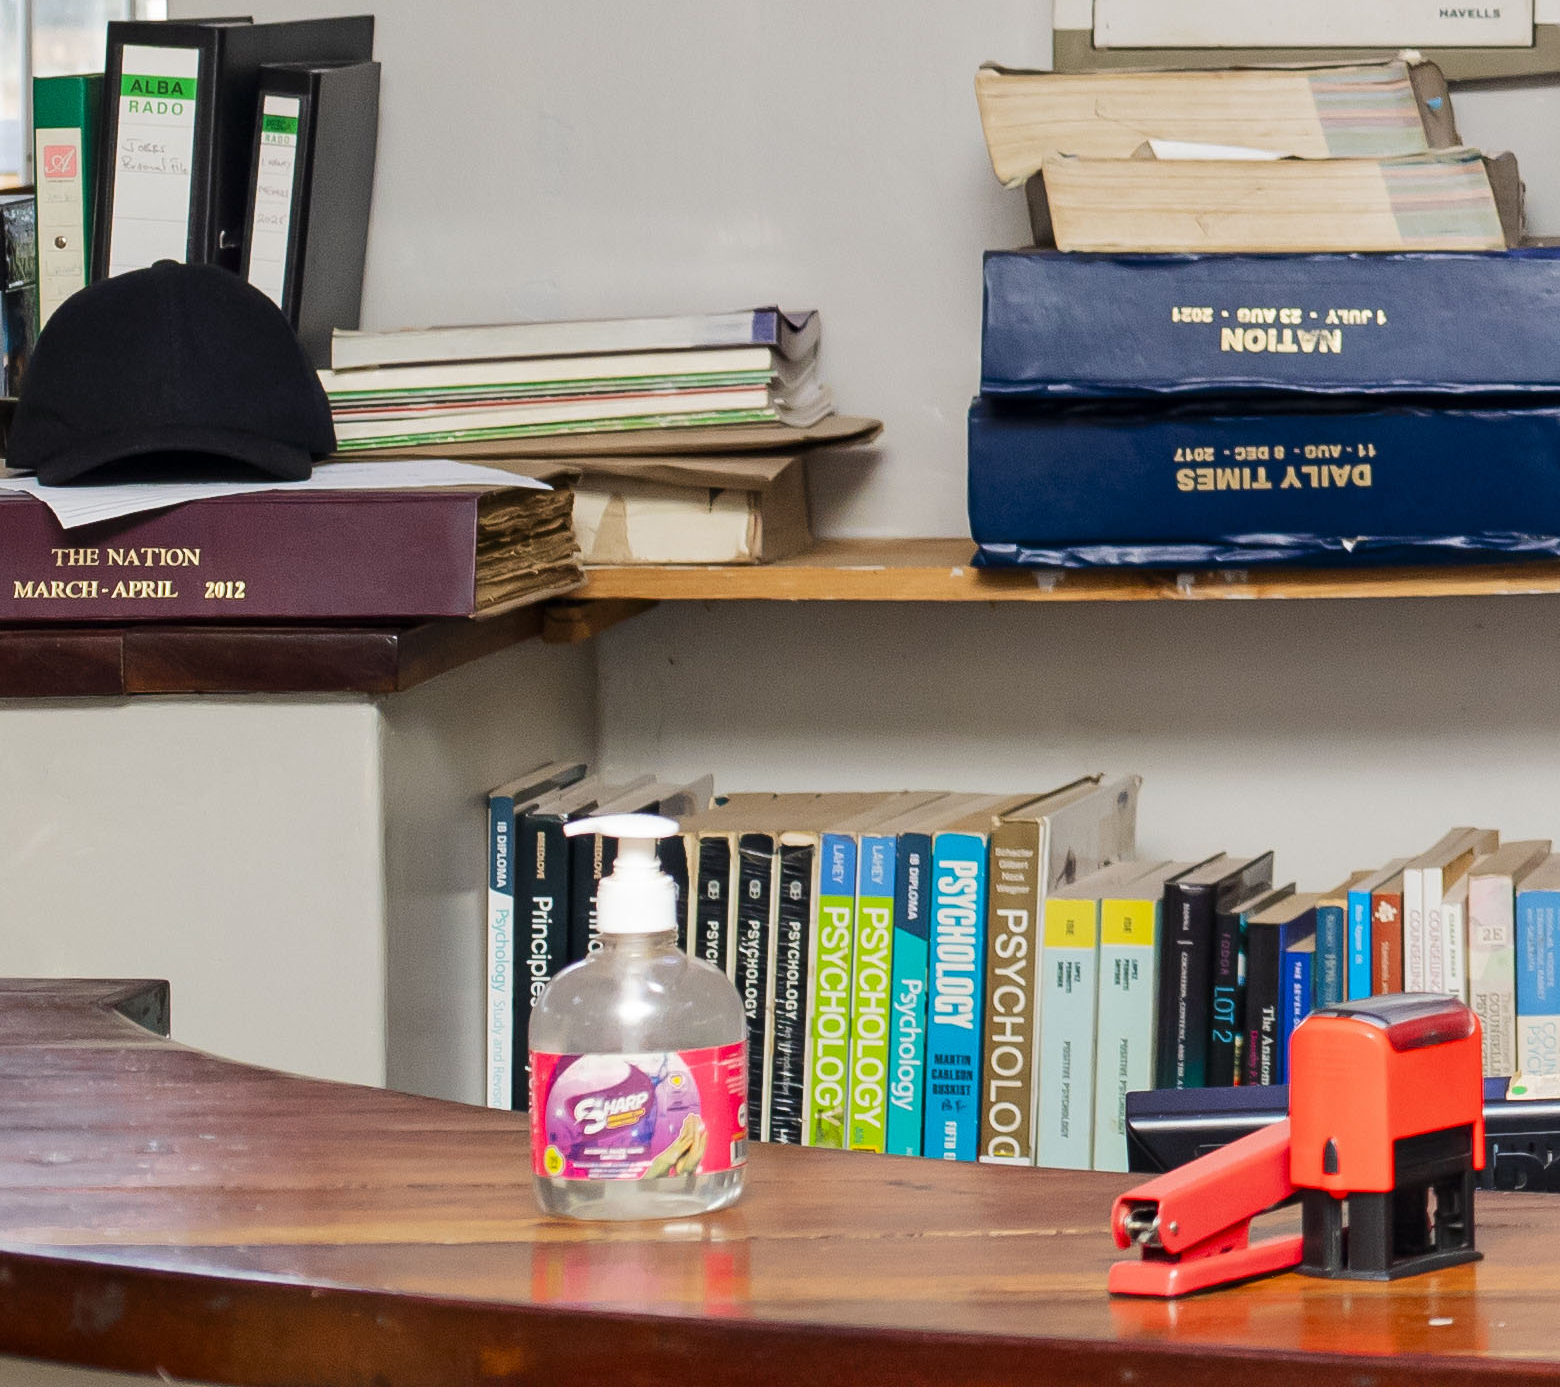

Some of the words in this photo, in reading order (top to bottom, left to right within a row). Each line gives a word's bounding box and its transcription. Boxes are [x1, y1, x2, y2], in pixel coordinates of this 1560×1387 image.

[1440, 9, 1500, 18] HAVELLS
[130, 79, 183, 95] ALBA
[129, 101, 183, 115] RADO
[1221, 328, 1341, 353] NATION
[1177, 467, 1272, 491] TIMES
[1280, 464, 1371, 488] DAILY
[52, 549, 99, 566] THE
[107, 548, 200, 566] NATION
[205, 581, 245, 598] 2012
[832, 845, 844, 885] LAHEY
[934, 861, 978, 1030] PSYCHOLOGY
[785, 922, 801, 1021] PSYCHOLOGY
[1214, 986, 1235, 1025] LOT
[854, 907, 889, 1129] PSYCHOLOGY
[891, 979, 922, 1111] Psychology
[1213, 1031, 1233, 1043] 2
